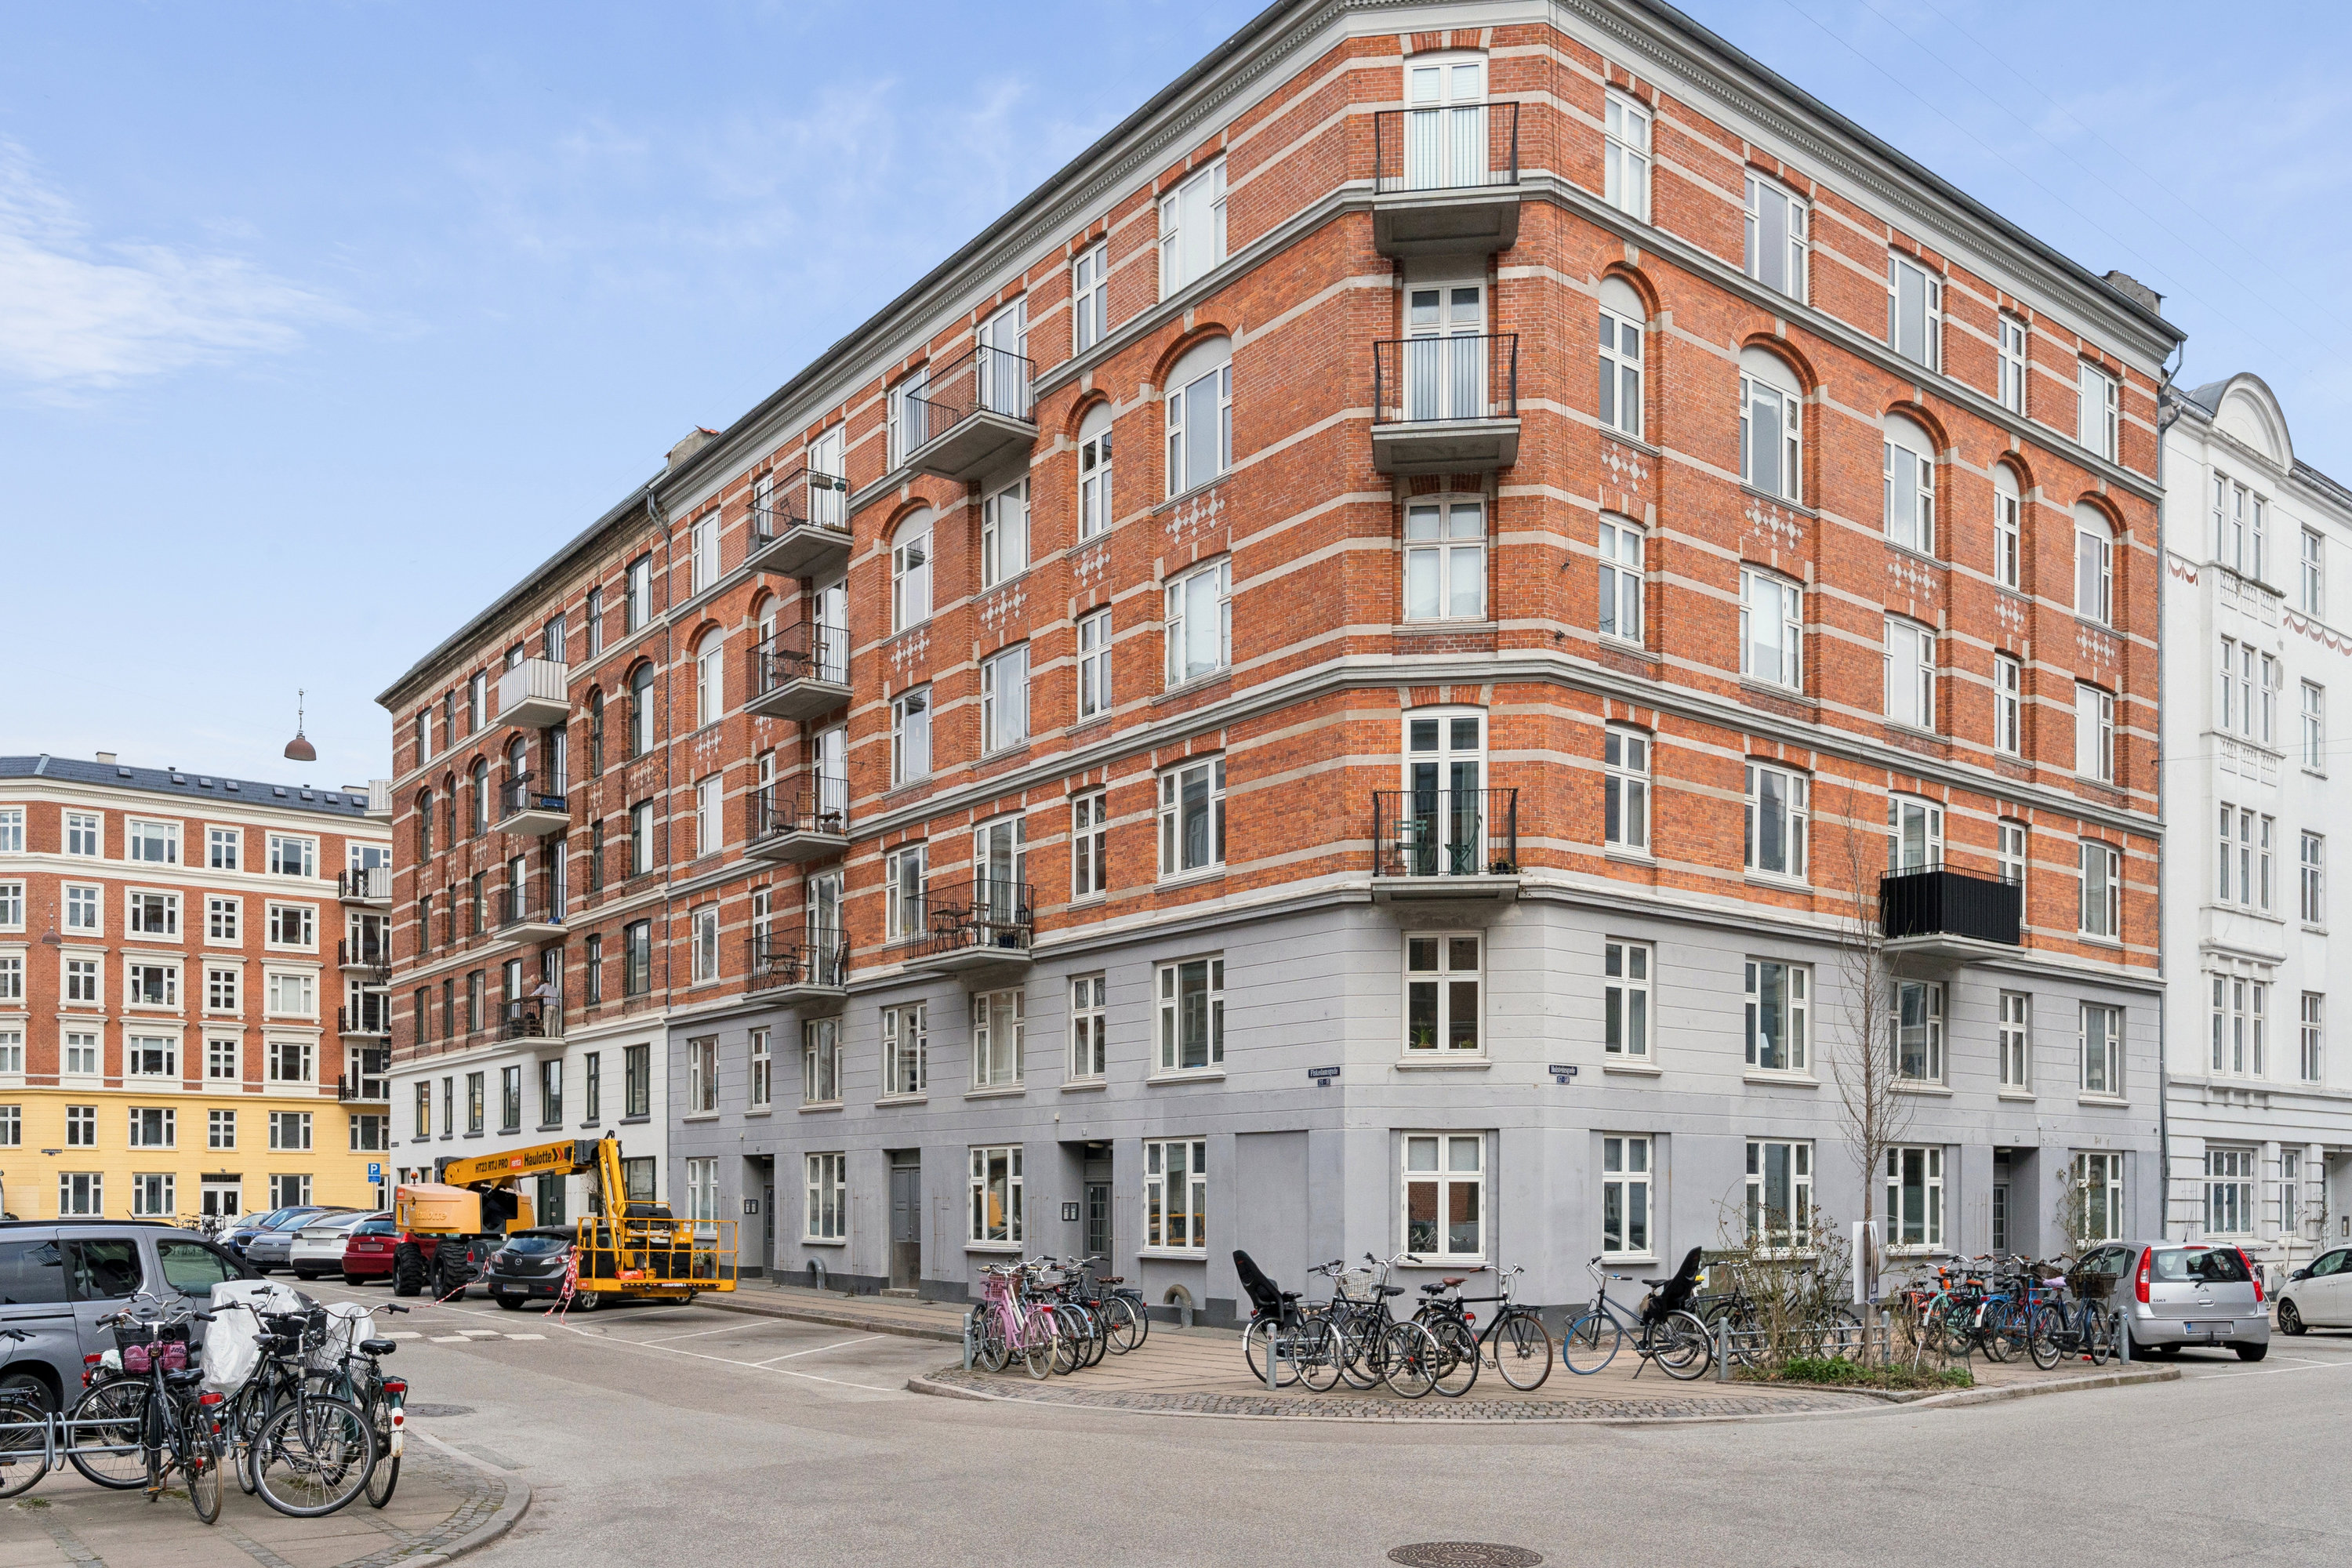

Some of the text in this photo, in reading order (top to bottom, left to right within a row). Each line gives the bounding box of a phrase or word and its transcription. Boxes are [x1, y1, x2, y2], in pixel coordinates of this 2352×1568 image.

[475, 1158, 508, 1173] HT23 RTJ PRO
[524, 1150, 552, 1167] Haulotte
[371, 1164, 378, 1174] P
